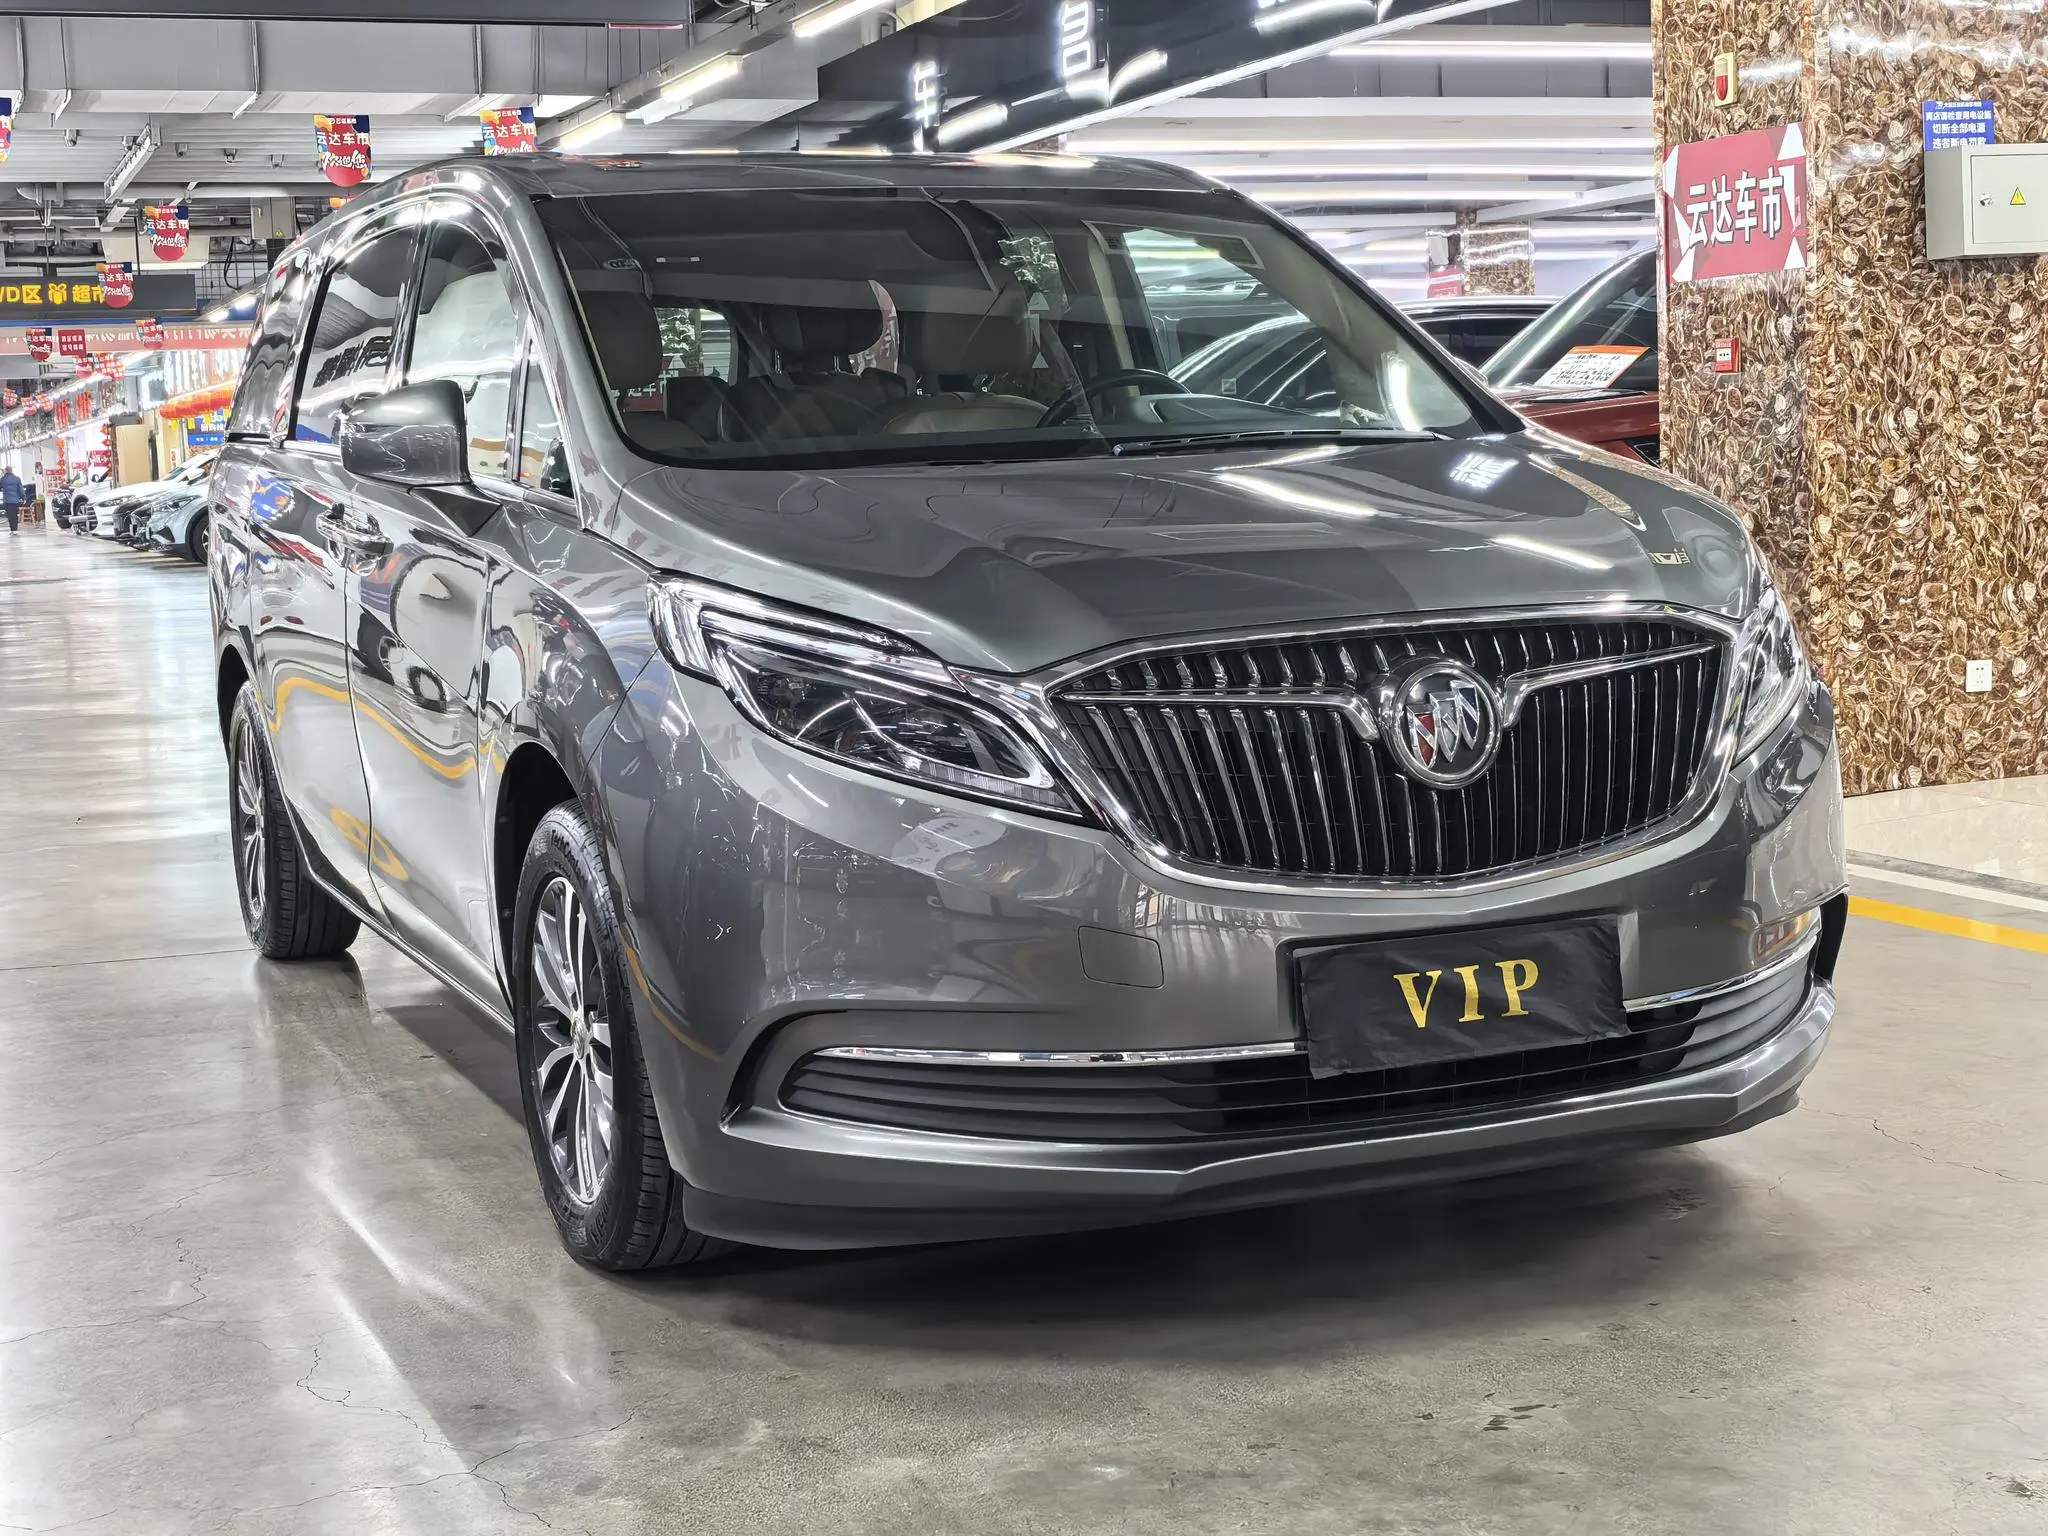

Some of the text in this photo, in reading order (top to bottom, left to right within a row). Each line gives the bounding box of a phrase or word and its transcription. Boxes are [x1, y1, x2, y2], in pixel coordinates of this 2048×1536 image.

[483, 124, 537, 138] 云达车市
[1932, 122, 1986, 134] 切断全部电源
[316, 131, 369, 146] 云达车市
[1686, 166, 1784, 249] 云达车市
[146, 219, 189, 230] 云达车市
[1393, 959, 1540, 1029] VIP
